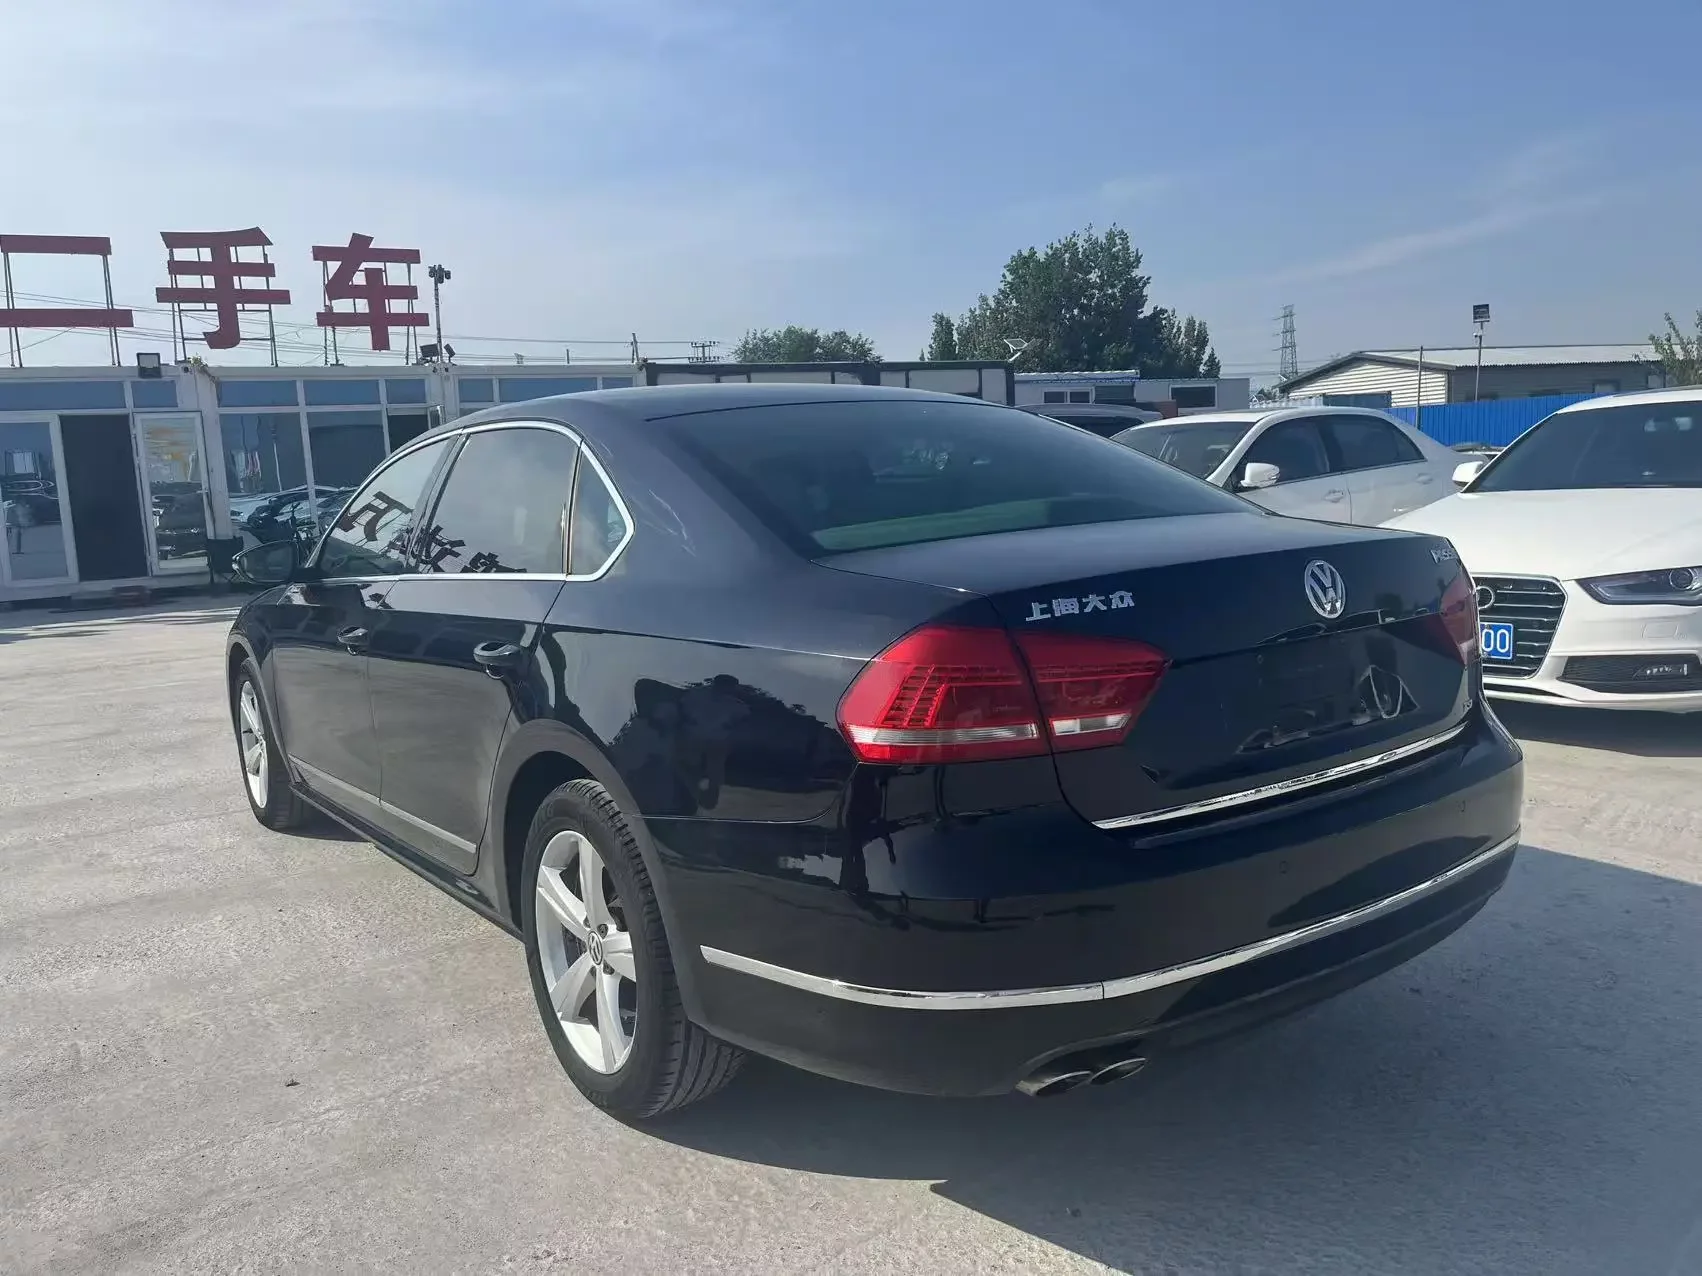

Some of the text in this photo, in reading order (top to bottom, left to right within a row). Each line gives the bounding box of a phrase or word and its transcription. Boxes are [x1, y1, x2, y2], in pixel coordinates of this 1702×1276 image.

[0, 227, 429, 351] 二手车
[1025, 590, 1135, 622] 上海大众
[1304, 559, 1346, 619] VW
